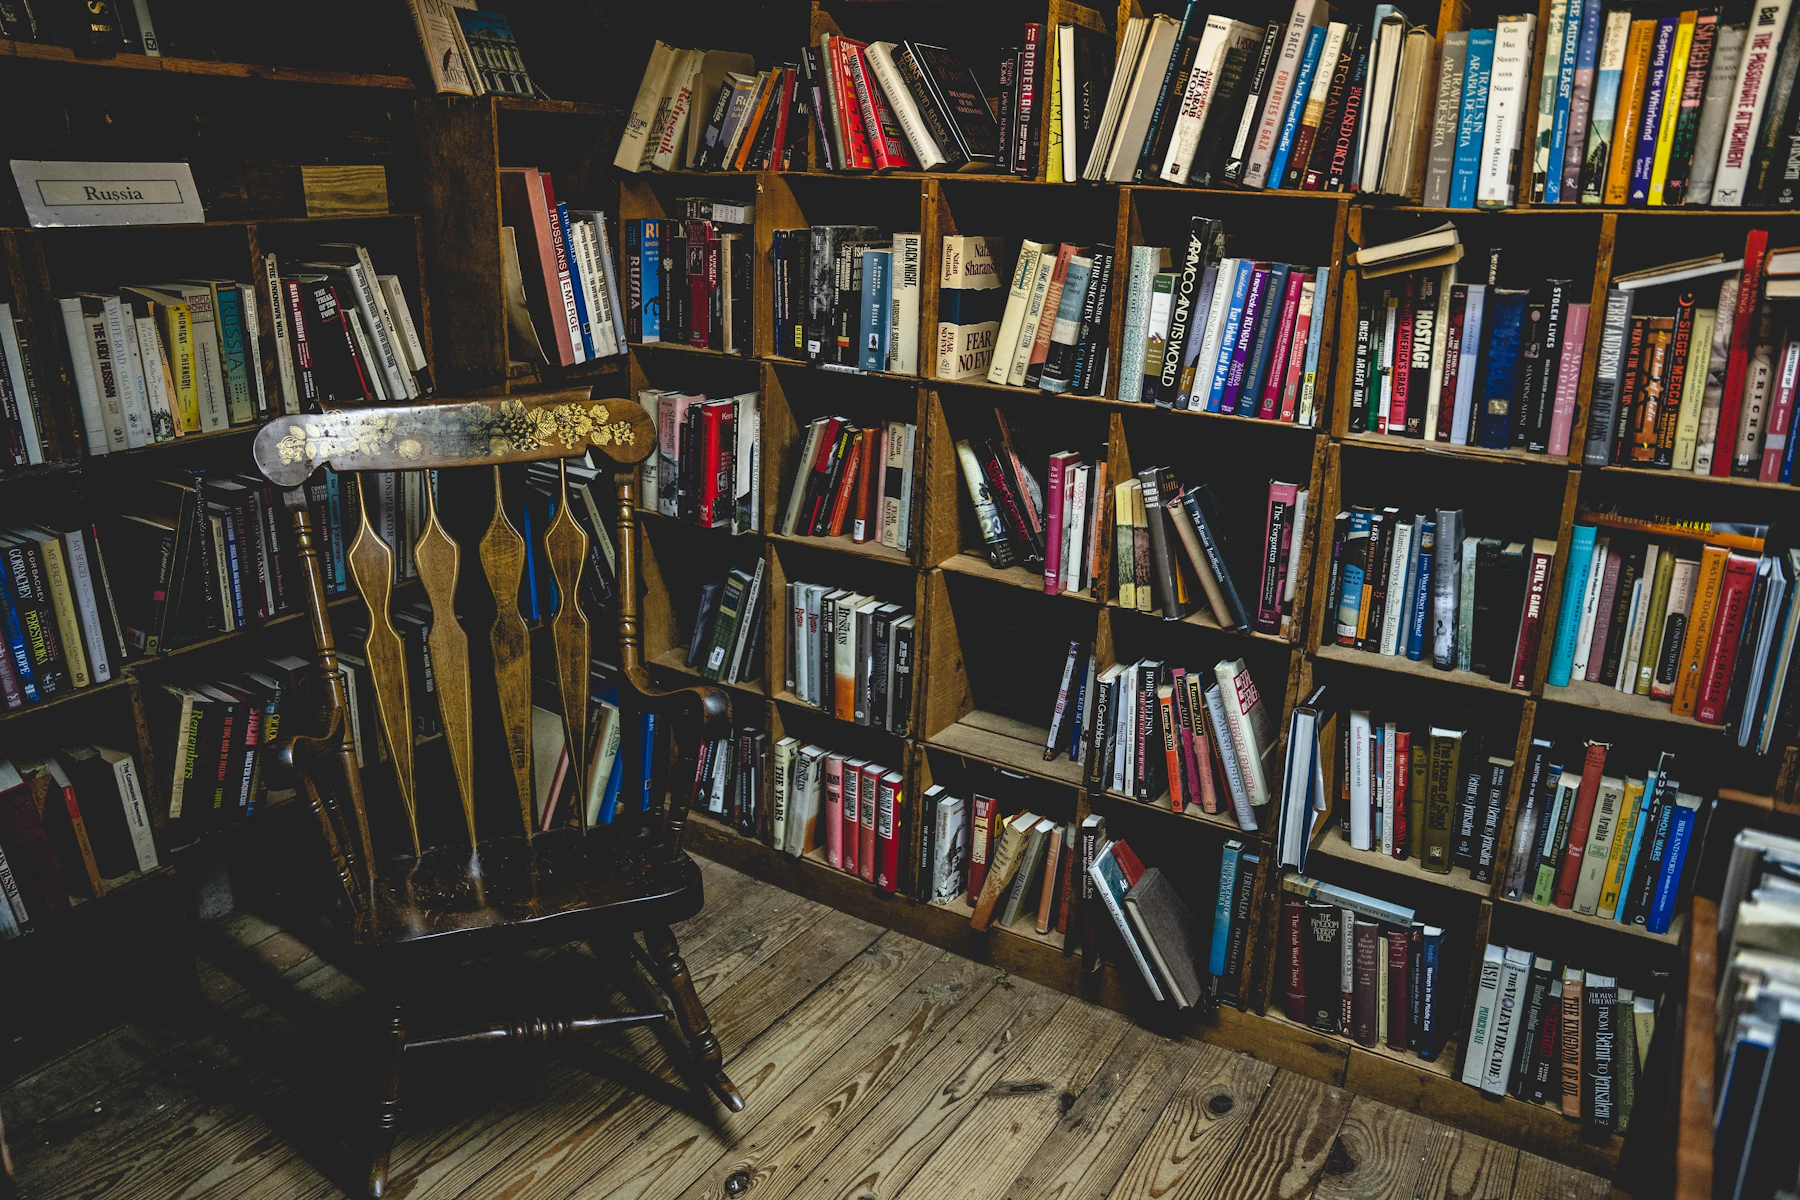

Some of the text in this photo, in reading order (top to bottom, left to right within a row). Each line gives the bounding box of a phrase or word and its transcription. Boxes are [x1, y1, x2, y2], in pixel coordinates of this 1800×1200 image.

[1285, 12, 1306, 59] JOE SACCO
[1751, 31, 1773, 50] THE
[1757, 6, 1779, 26] Ball
[1252, 29, 1276, 91] The Silent Steppe
[1558, 18, 1580, 100] MIDDLE EAST
[1687, 22, 1715, 68] SACRED
[1020, 43, 1036, 122] BORDERLAND
[1181, 67, 1201, 116] PEOPLES
[1188, 68, 1210, 118] THE ARAB
[1279, 61, 1313, 152] The Conflict
[1433, 55, 1455, 147] ARABIA DESERTA
[1448, 71, 1463, 123] TRAVELS
[1459, 54, 1481, 148] ARABIA DESERTA
[1474, 69, 1490, 121] TRAVELS
[1643, 24, 1674, 141] Reaping the Whirlwind
[1738, 52, 1768, 108] PASSIONATE
[659, 86, 693, 156] Refusenik
[913, 81, 950, 146] DAVID REMNICK
[998, 91, 1009, 152] DAVID REMNICK
[1257, 69, 1289, 151] FOOTNOTES IN GAZA
[1311, 52, 1352, 165] AFGHANISTAN
[1338, 95, 1361, 140] CLOSED
[1329, 139, 1350, 176] CIRCLE
[1725, 110, 1754, 170] ATTACHMENT
[84, 185, 144, 204] Russia
[550, 212, 580, 334] RUSSIANS EMERGE
[905, 237, 918, 264] BLACK
[952, 251, 960, 276] Natan
[1012, 247, 1031, 290] MOSCOW
[1022, 249, 1039, 292] BREAKING
[268, 261, 285, 339] THE UNKNOWN WAR
[629, 256, 641, 311] RUSSIA
[1083, 252, 1104, 323] KHRUSHCHEV
[1093, 254, 1113, 325] EDWARD CRANKSHAW
[1160, 232, 1204, 388] ARAMCO AND ITS WORLD
[221, 299, 244, 373] RUSSIA
[946, 331, 954, 352] FEAR
[966, 329, 993, 352] FEAR
[1237, 314, 1255, 352] KUWAIT
[1410, 308, 1435, 370] HOSTAGE
[1545, 286, 1563, 350] STOLEN LIVES
[1598, 295, 1630, 380] TERRY ANDERSON
[177, 311, 191, 391] MIDNIGHT CHERNOBYL
[958, 354, 975, 374] NO
[1071, 348, 1086, 388] CAREER
[1352, 319, 1370, 409] ONCE AN ARAFAT MAN
[1395, 328, 1409, 397] AMERICA'S GRASP
[1667, 320, 1692, 407] SIEGE MECCA
[1553, 341, 1573, 416] PROPHET
[1565, 352, 1582, 405] MANTLE
[888, 426, 897, 462] Sharansky
[1191, 510, 1202, 525] The
[1268, 503, 1284, 564] The Forgotten
[1369, 523, 1379, 542] IRAQ
[1599, 512, 1622, 525] DAVID
[1676, 518, 1712, 531] CRISIS
[27, 549, 45, 603] GORBACHEV
[1527, 557, 1548, 620] DEVIL'S GAME
[1381, 615, 1397, 655] Edinburgh
[1694, 558, 1720, 662] WAS TOLD COME ALONE
[14, 653, 31, 676] HOPE
[24, 609, 49, 666] PERESTROIKA
[1710, 589, 1744, 704] STONES SCHOOLS
[245, 707, 261, 745] STALIN
[1144, 670, 1156, 737] BORIS YELTSIN
[1161, 705, 1175, 751] Russia 2010
[1176, 676, 1191, 729] Russia 2010
[1189, 682, 1205, 736] Russia 2010
[184, 709, 204, 780] Remembers
[242, 750, 255, 776] WALTER
[1137, 753, 1145, 781] RUSSIA
[1215, 710, 1245, 794] FAILED EMPIRE
[773, 765, 784, 822] THE YEARS
[1594, 792, 1618, 842] Saudi Arabia
[1649, 769, 1668, 822] KUWAIT
[1651, 804, 1673, 863] UNHOLY WARS
[1666, 851, 1679, 876] SWORD
[1102, 892, 1124, 928] Arabia Felix
[1237, 870, 1254, 921] JERUSALEM
[1231, 939, 1240, 958] living
[1290, 924, 1300, 989] Arab World Today
[1489, 972, 1518, 1080] THE DECADE
[1598, 1006, 1610, 1030] FROM
[1561, 995, 1580, 1098] THE KINGDOM OF OIL
